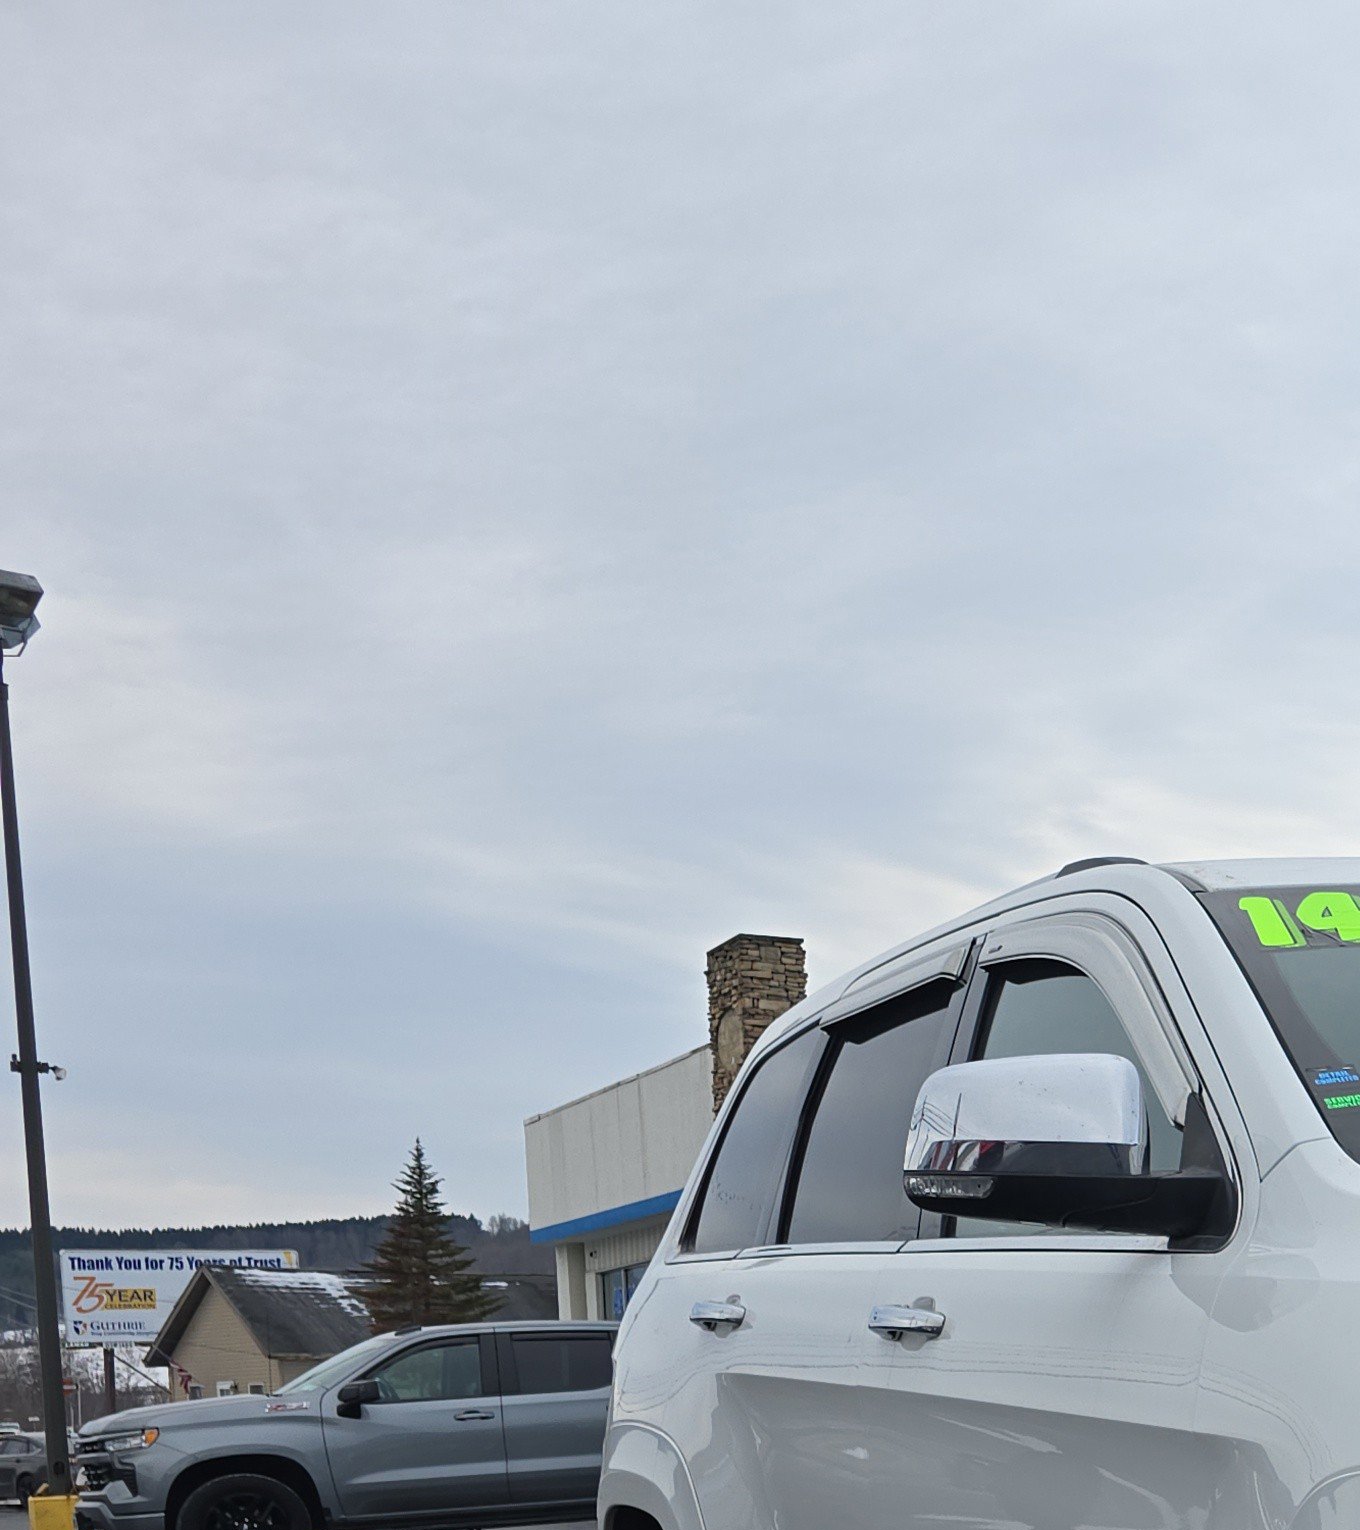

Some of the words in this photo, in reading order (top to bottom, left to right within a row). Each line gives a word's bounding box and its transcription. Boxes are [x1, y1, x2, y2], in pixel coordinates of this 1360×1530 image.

[68, 1256, 113, 1271] Thank
[115, 1256, 141, 1270] You
[145, 1257, 165, 1270] for
[167, 1256, 184, 1270] 75
[245, 1256, 282, 1268] Trust
[72, 1276, 114, 1314] 75
[105, 1289, 154, 1302] YEAR
[91, 1320, 146, 1331] GUTHRIE
